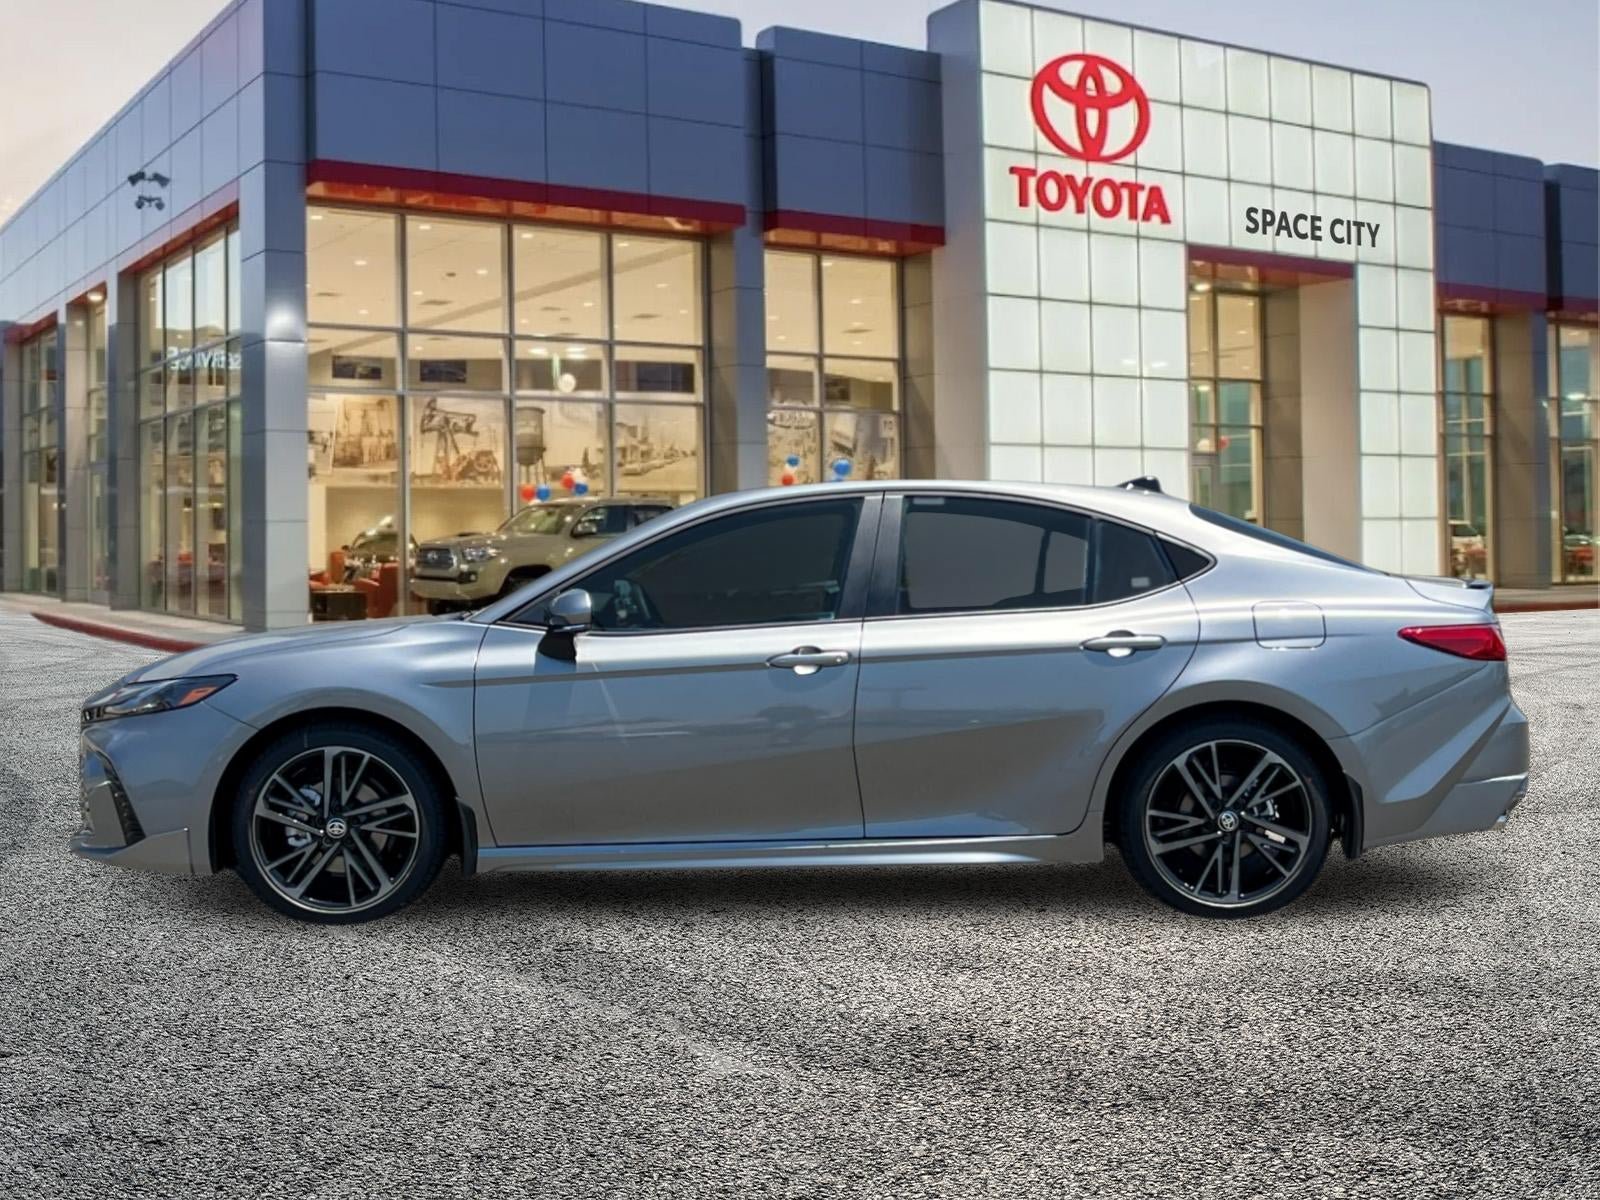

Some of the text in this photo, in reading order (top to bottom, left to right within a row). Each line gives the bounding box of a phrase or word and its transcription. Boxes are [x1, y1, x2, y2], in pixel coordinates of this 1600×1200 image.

[1009, 166, 1171, 224] TOYOTA
[1245, 206, 1380, 248] SPACE CITY
